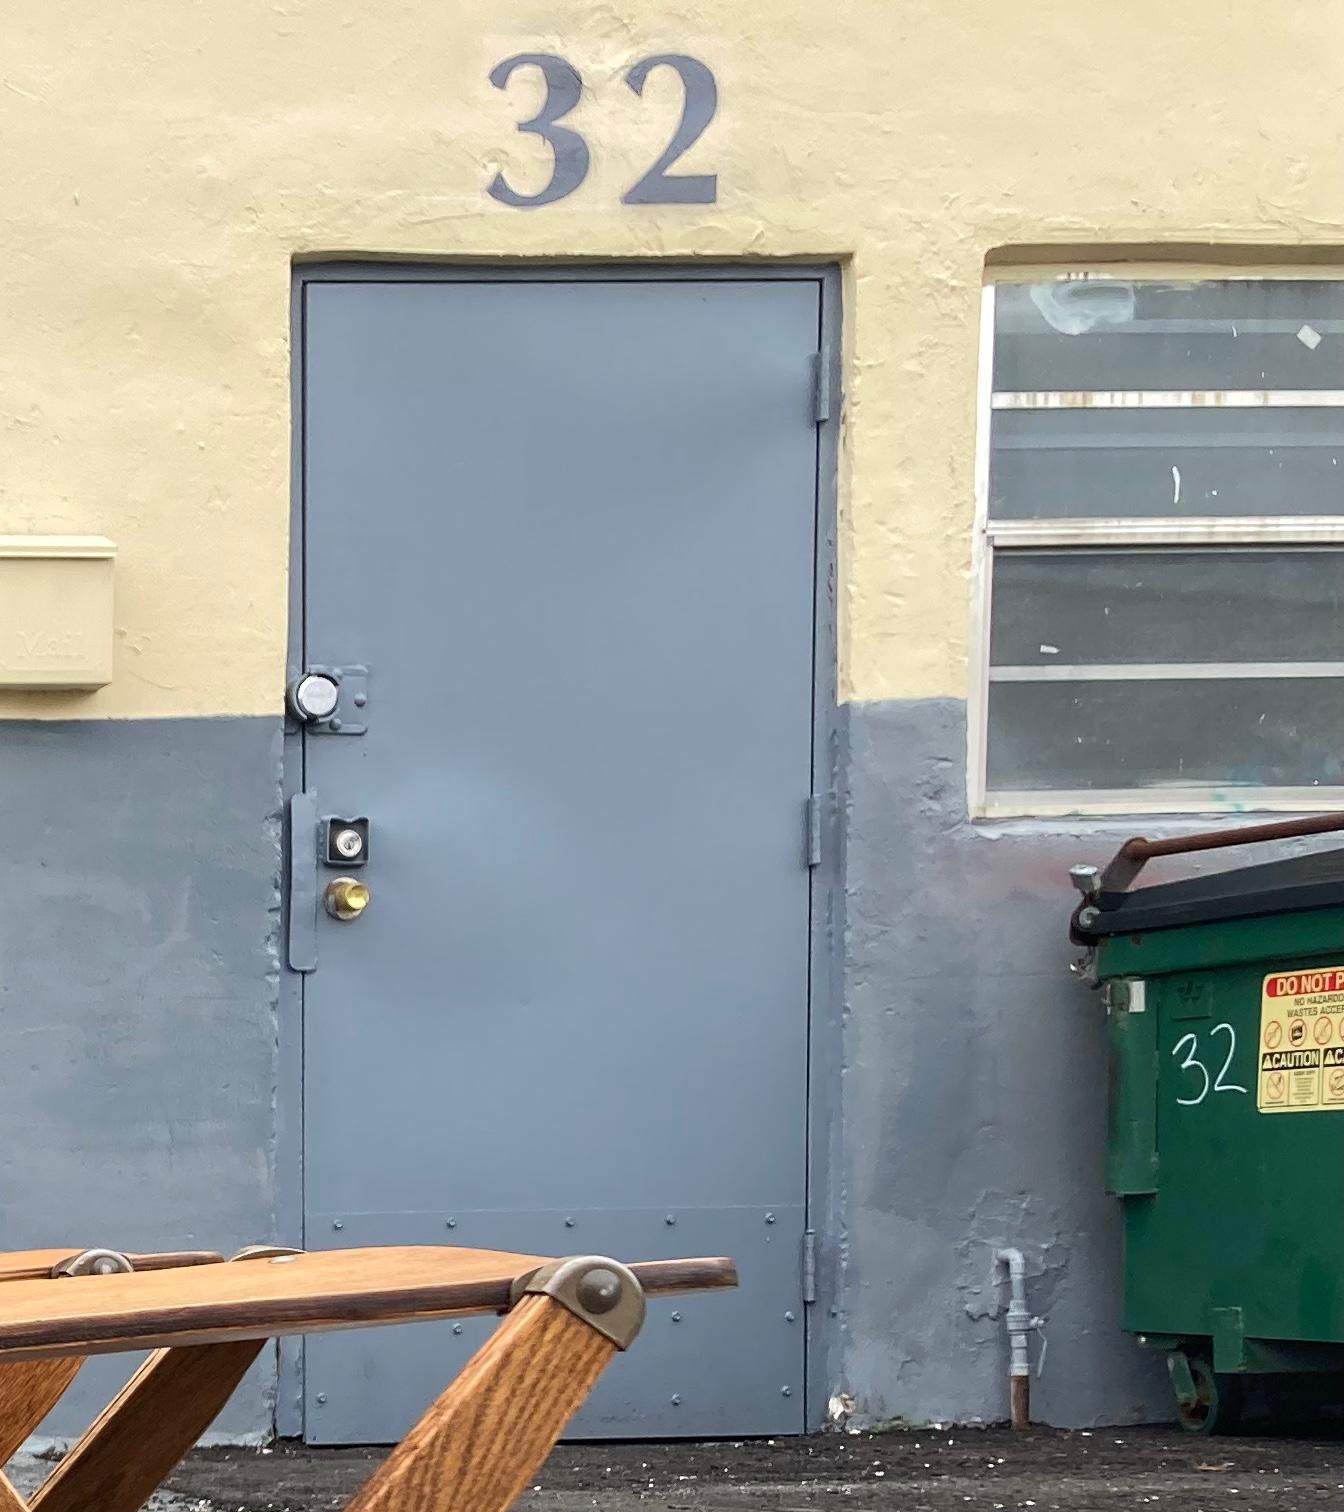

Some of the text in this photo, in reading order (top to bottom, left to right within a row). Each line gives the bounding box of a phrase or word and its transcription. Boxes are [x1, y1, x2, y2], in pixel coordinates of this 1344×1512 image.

[486, 53, 718, 207] 32
[1276, 977, 1298, 996] DO
[1300, 972, 1332, 994] NOT
[1287, 1006, 1318, 1018] WASTES
[1294, 997, 1305, 1006] NO
[1172, 1023, 1248, 1105] 32
[1272, 1050, 1319, 1069] CAUTION
